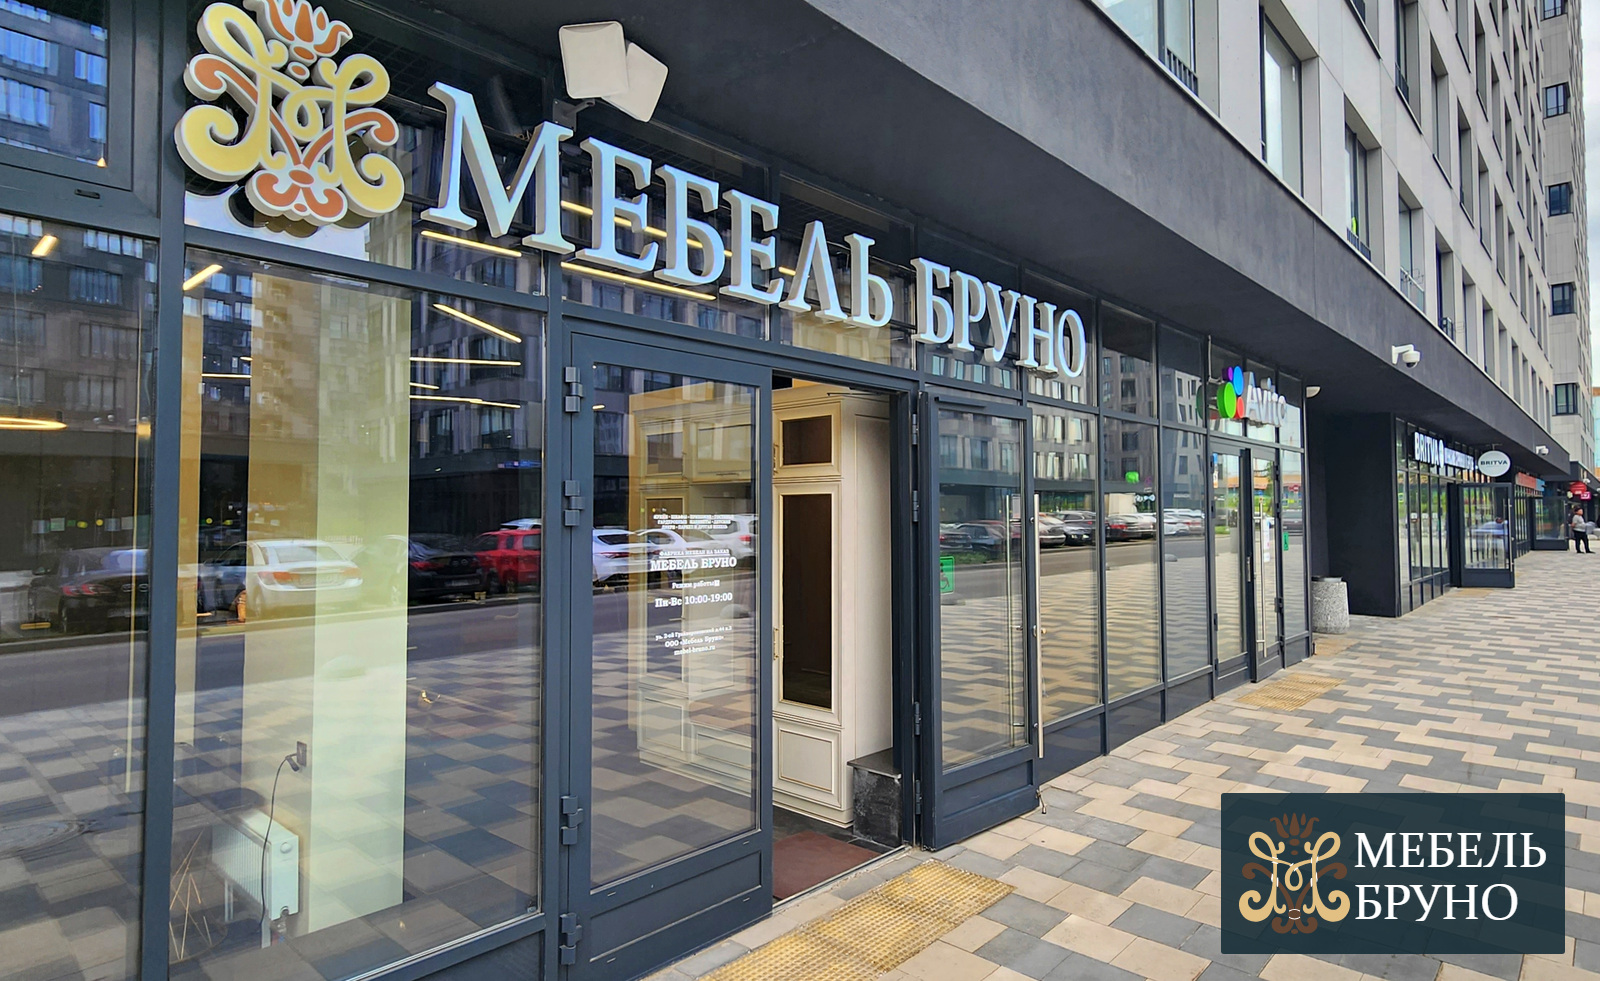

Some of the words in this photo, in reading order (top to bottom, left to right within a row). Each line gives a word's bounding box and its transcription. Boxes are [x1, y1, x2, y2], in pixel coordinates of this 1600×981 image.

[420, 81, 894, 328] МЕБЕЛЬ
[910, 257, 1087, 377] БРУНО
[1244, 371, 1287, 428] Avito
[1414, 431, 1440, 466] BRITVA
[650, 558, 699, 572] МЕБЕЛЬ
[700, 556, 738, 569] БРУНО
[672, 582, 693, 590] Режим
[655, 597, 682, 608] Пн-Вс
[684, 593, 733, 605] 10:00-19:00
